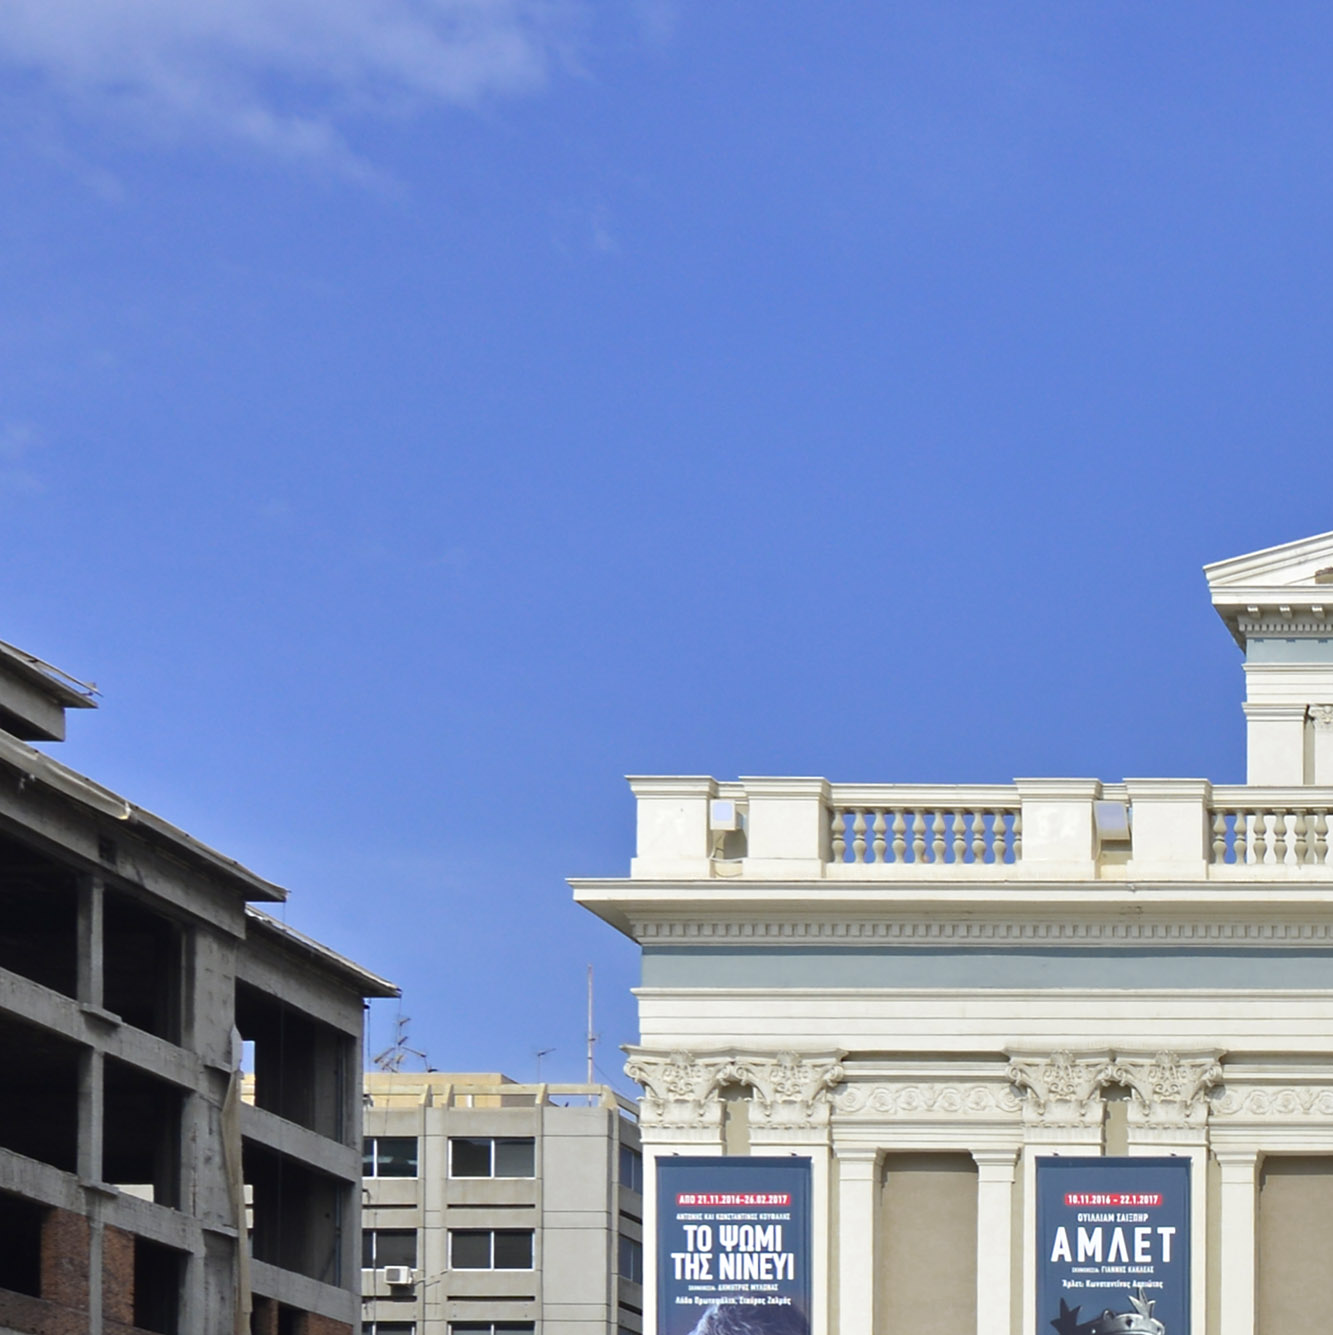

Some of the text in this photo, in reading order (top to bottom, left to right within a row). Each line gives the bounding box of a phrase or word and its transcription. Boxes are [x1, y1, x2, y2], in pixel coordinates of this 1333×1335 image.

[679, 1195, 696, 1204] ΑΠΟ
[1068, 1194, 1111, 1204] 10.11.2016
[1120, 1194, 1158, 1204] 22.1.2017
[683, 1225, 782, 1252] ΤΟ ΨΩΜΙ
[1050, 1226, 1176, 1262] ΑΜΛΕΤ
[670, 1253, 794, 1280] ΤΗΣ ΝΙΝΕΥΙ
